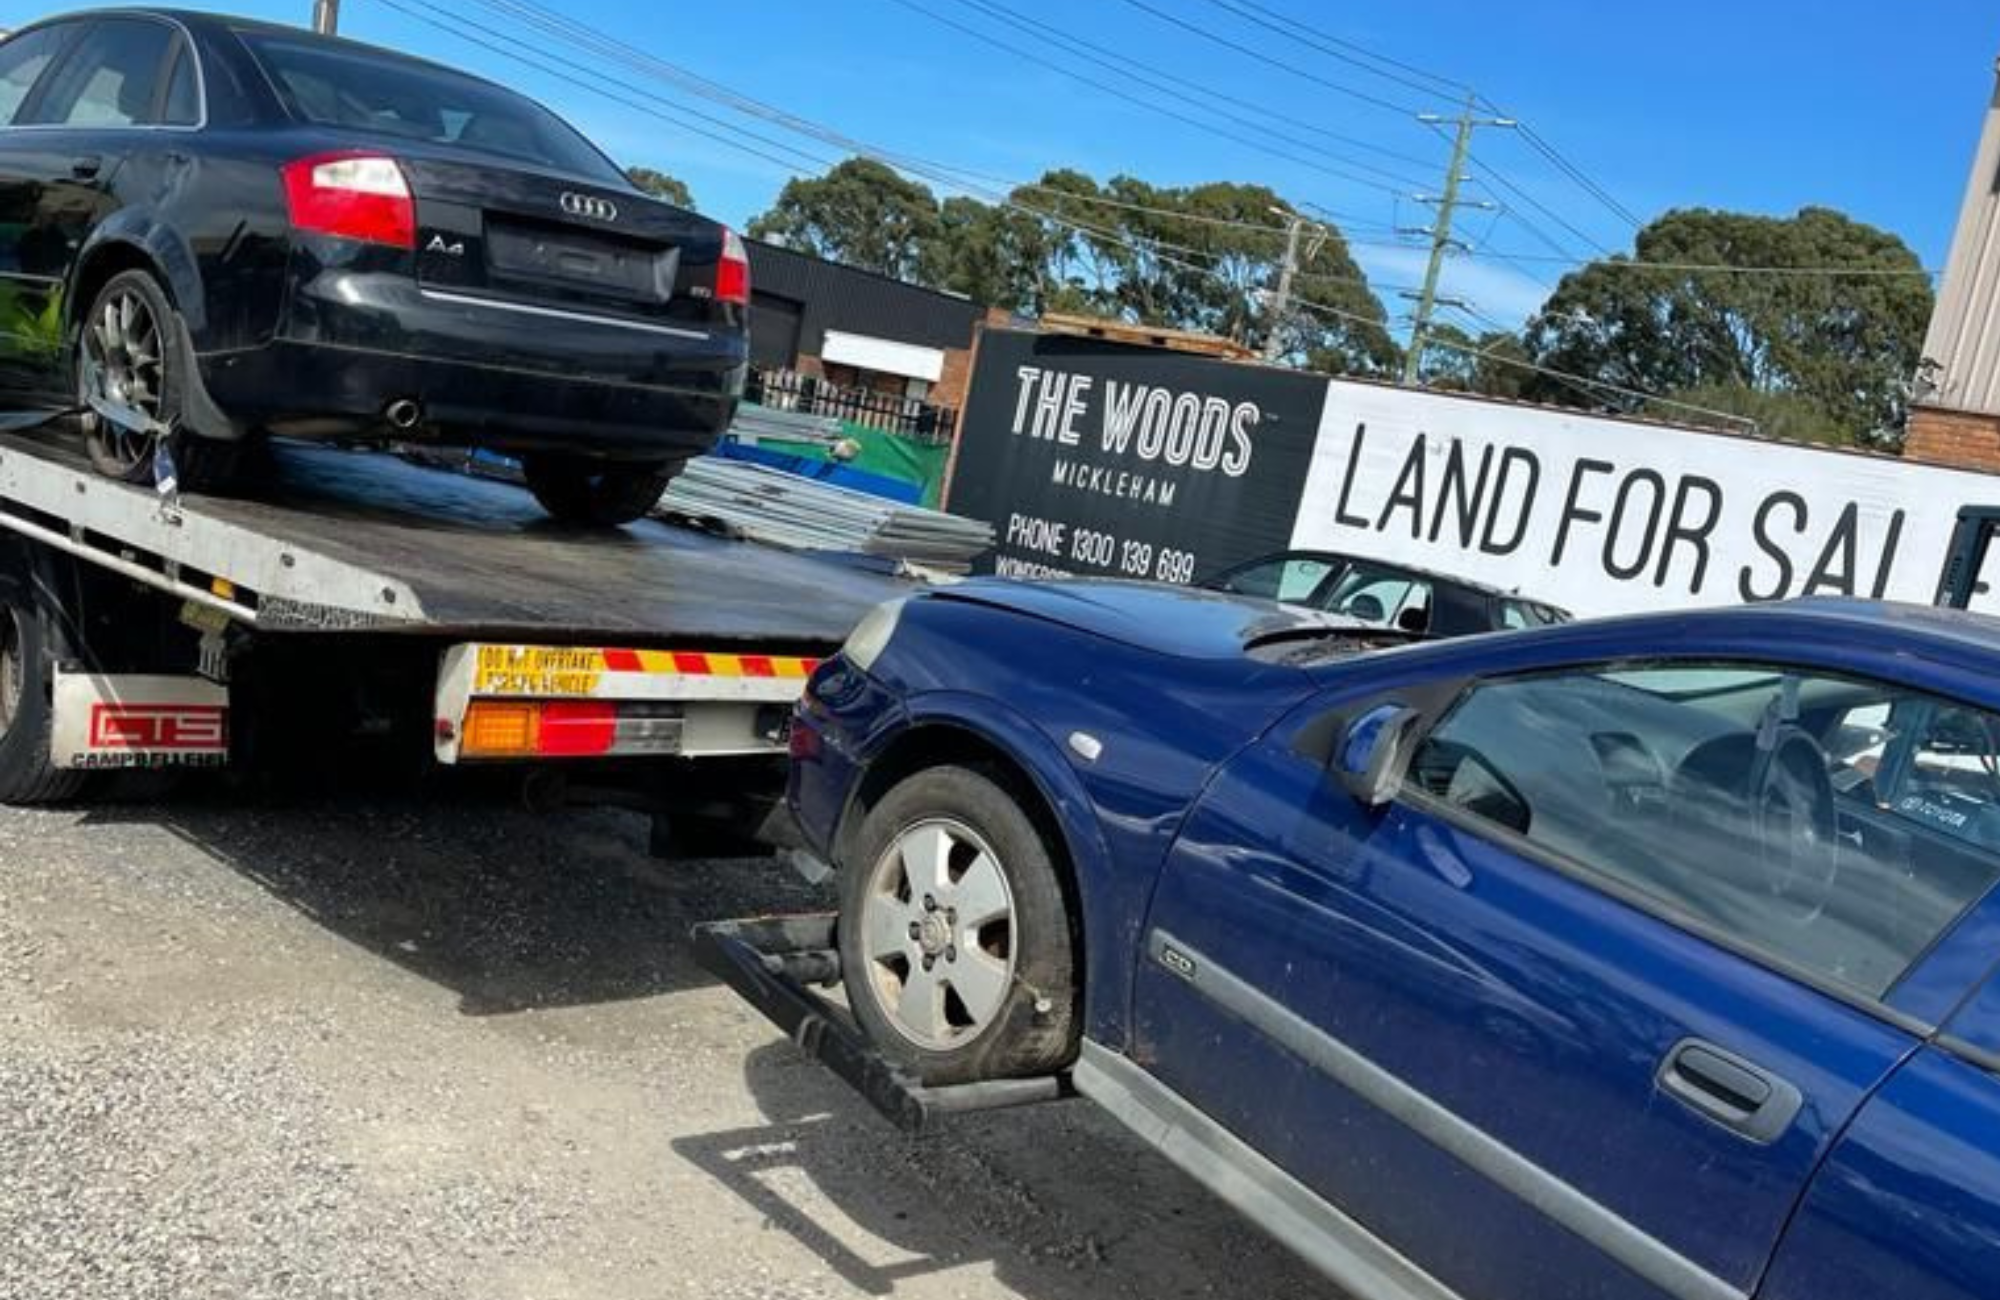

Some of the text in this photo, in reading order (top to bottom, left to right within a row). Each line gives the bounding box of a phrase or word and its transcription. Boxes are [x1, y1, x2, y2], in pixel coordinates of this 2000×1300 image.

[426, 233, 464, 255] A4
[1011, 366, 1261, 478] THE WOODS
[1052, 459, 1176, 506] MICKLEHAM
[1334, 422, 1541, 556] LAND
[1550, 457, 1723, 595] FOR
[1006, 512, 1195, 583] PHONE 1300 139 699
